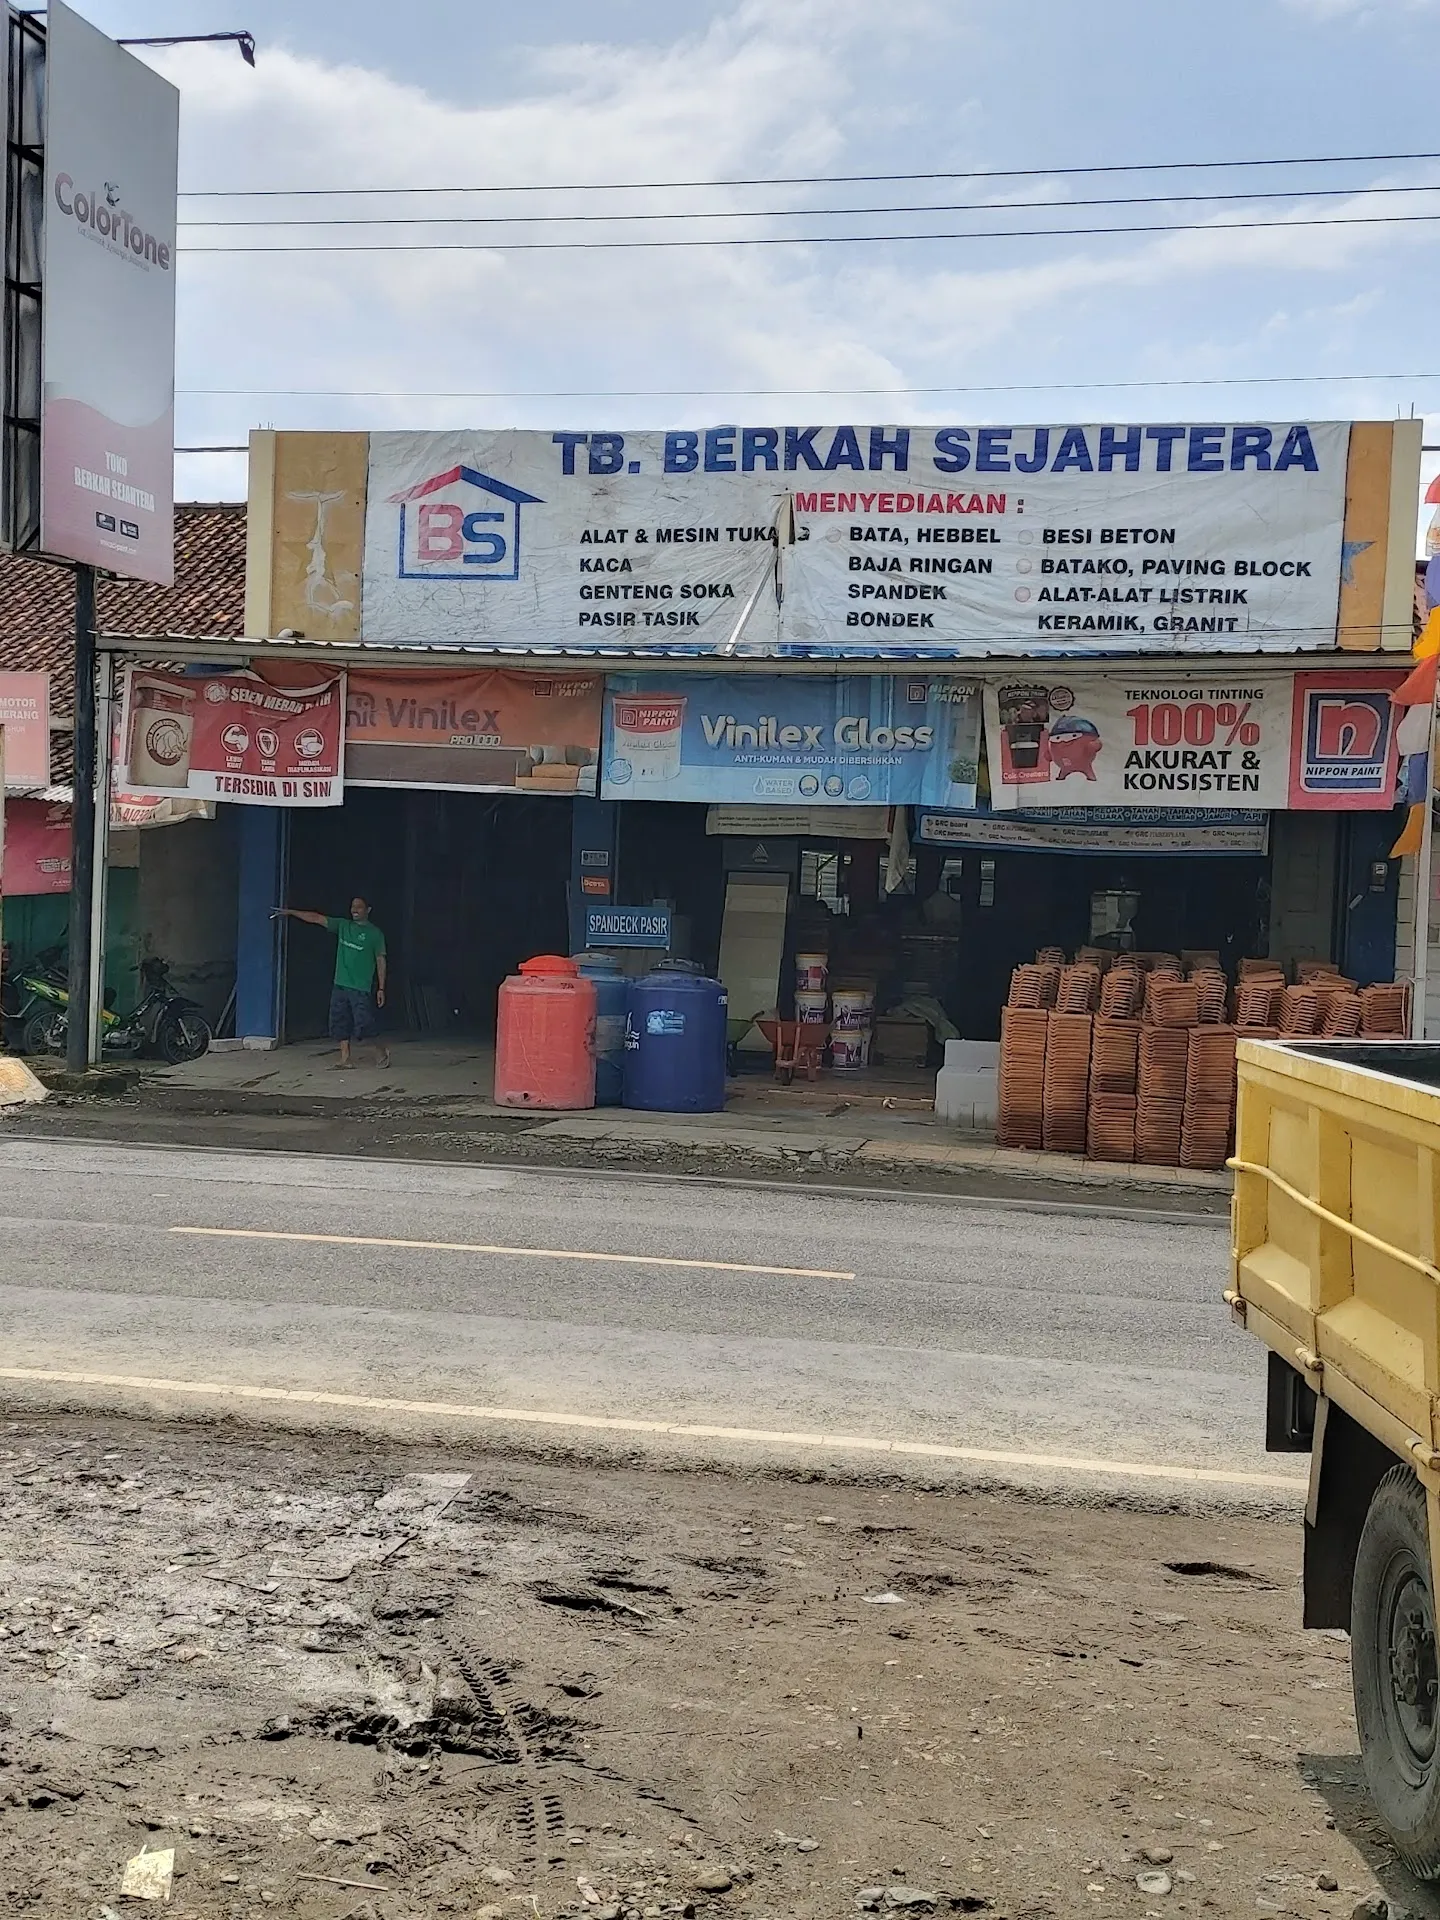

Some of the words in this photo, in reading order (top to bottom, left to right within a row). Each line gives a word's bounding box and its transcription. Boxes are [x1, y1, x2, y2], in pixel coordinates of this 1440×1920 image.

[54, 172, 169, 270] ColorTone
[552, 432, 641, 475] TB.
[664, 427, 910, 474] BERKAH
[933, 426, 1320, 473] SEJAHTERA
[104, 451, 128, 477] TOKO
[74, 466, 112, 497] BERKAH
[111, 480, 155, 513] SEJAHTERA
[795, 493, 1006, 514] MENYEDIAKAN
[418, 504, 506, 564] BS
[579, 529, 629, 544] ALAT
[634, 528, 649, 544] &
[656, 528, 720, 543] MESIN
[726, 526, 810, 542] TUKAG
[850, 527, 909, 546] BATA,
[917, 528, 1001, 544] HEBBEL
[1042, 528, 1093, 544] BESI
[1100, 528, 1176, 544] BETON
[579, 557, 633, 573] KACA
[849, 556, 903, 572] BAJA
[909, 558, 993, 574] RINGAN
[1041, 559, 1134, 577] BATAKO,
[1142, 559, 1226, 576] PAVING
[1234, 561, 1312, 577] BLOCK
[579, 584, 673, 600] GENTENG
[680, 583, 735, 599] SOKA
[848, 583, 947, 600] SPANDEK
[1037, 587, 1153, 602] ALAT-ALAT
[1160, 588, 1248, 604] LISTRIK
[578, 612, 636, 627] PASIR
[642, 611, 701, 627] TASIK
[846, 611, 935, 628] BONDEK
[1038, 615, 1145, 633] KERAMIK,
[1153, 616, 1239, 632] GRANIT
[929, 684, 975, 695] NIPPON
[1124, 689, 1203, 700] TEKNOLOGI
[1208, 688, 1264, 699] TINTING
[934, 694, 969, 703] PAINT
[0, 710, 40, 720] ERANG
[385, 697, 501, 732] Vinilex
[639, 709, 679, 718] NIPPON
[643, 718, 675, 726] PAINT
[1126, 703, 1260, 747] 100%
[700, 715, 826, 752] Vinilex
[833, 716, 934, 753] Gloss
[734, 754, 793, 764] ANTI-KUMAN
[795, 754, 802, 764] &
[803, 755, 837, 765] MUDAH
[839, 755, 903, 765] DIBERSIHKAN
[1124, 750, 1233, 769] AKURAT
[1241, 750, 1261, 769] &
[1305, 766, 1348, 776] NIPPON
[1351, 766, 1382, 776] PAINT
[215, 776, 277, 797] TERSEDIA
[282, 781, 298, 797] DI
[765, 779, 793, 787] WATER
[765, 787, 792, 795] BASED
[1124, 773, 1259, 792] KONSISTEN
[935, 821, 949, 829] GRC
[589, 914, 639, 933] SPANDECK
[640, 916, 667, 934] PASIR
